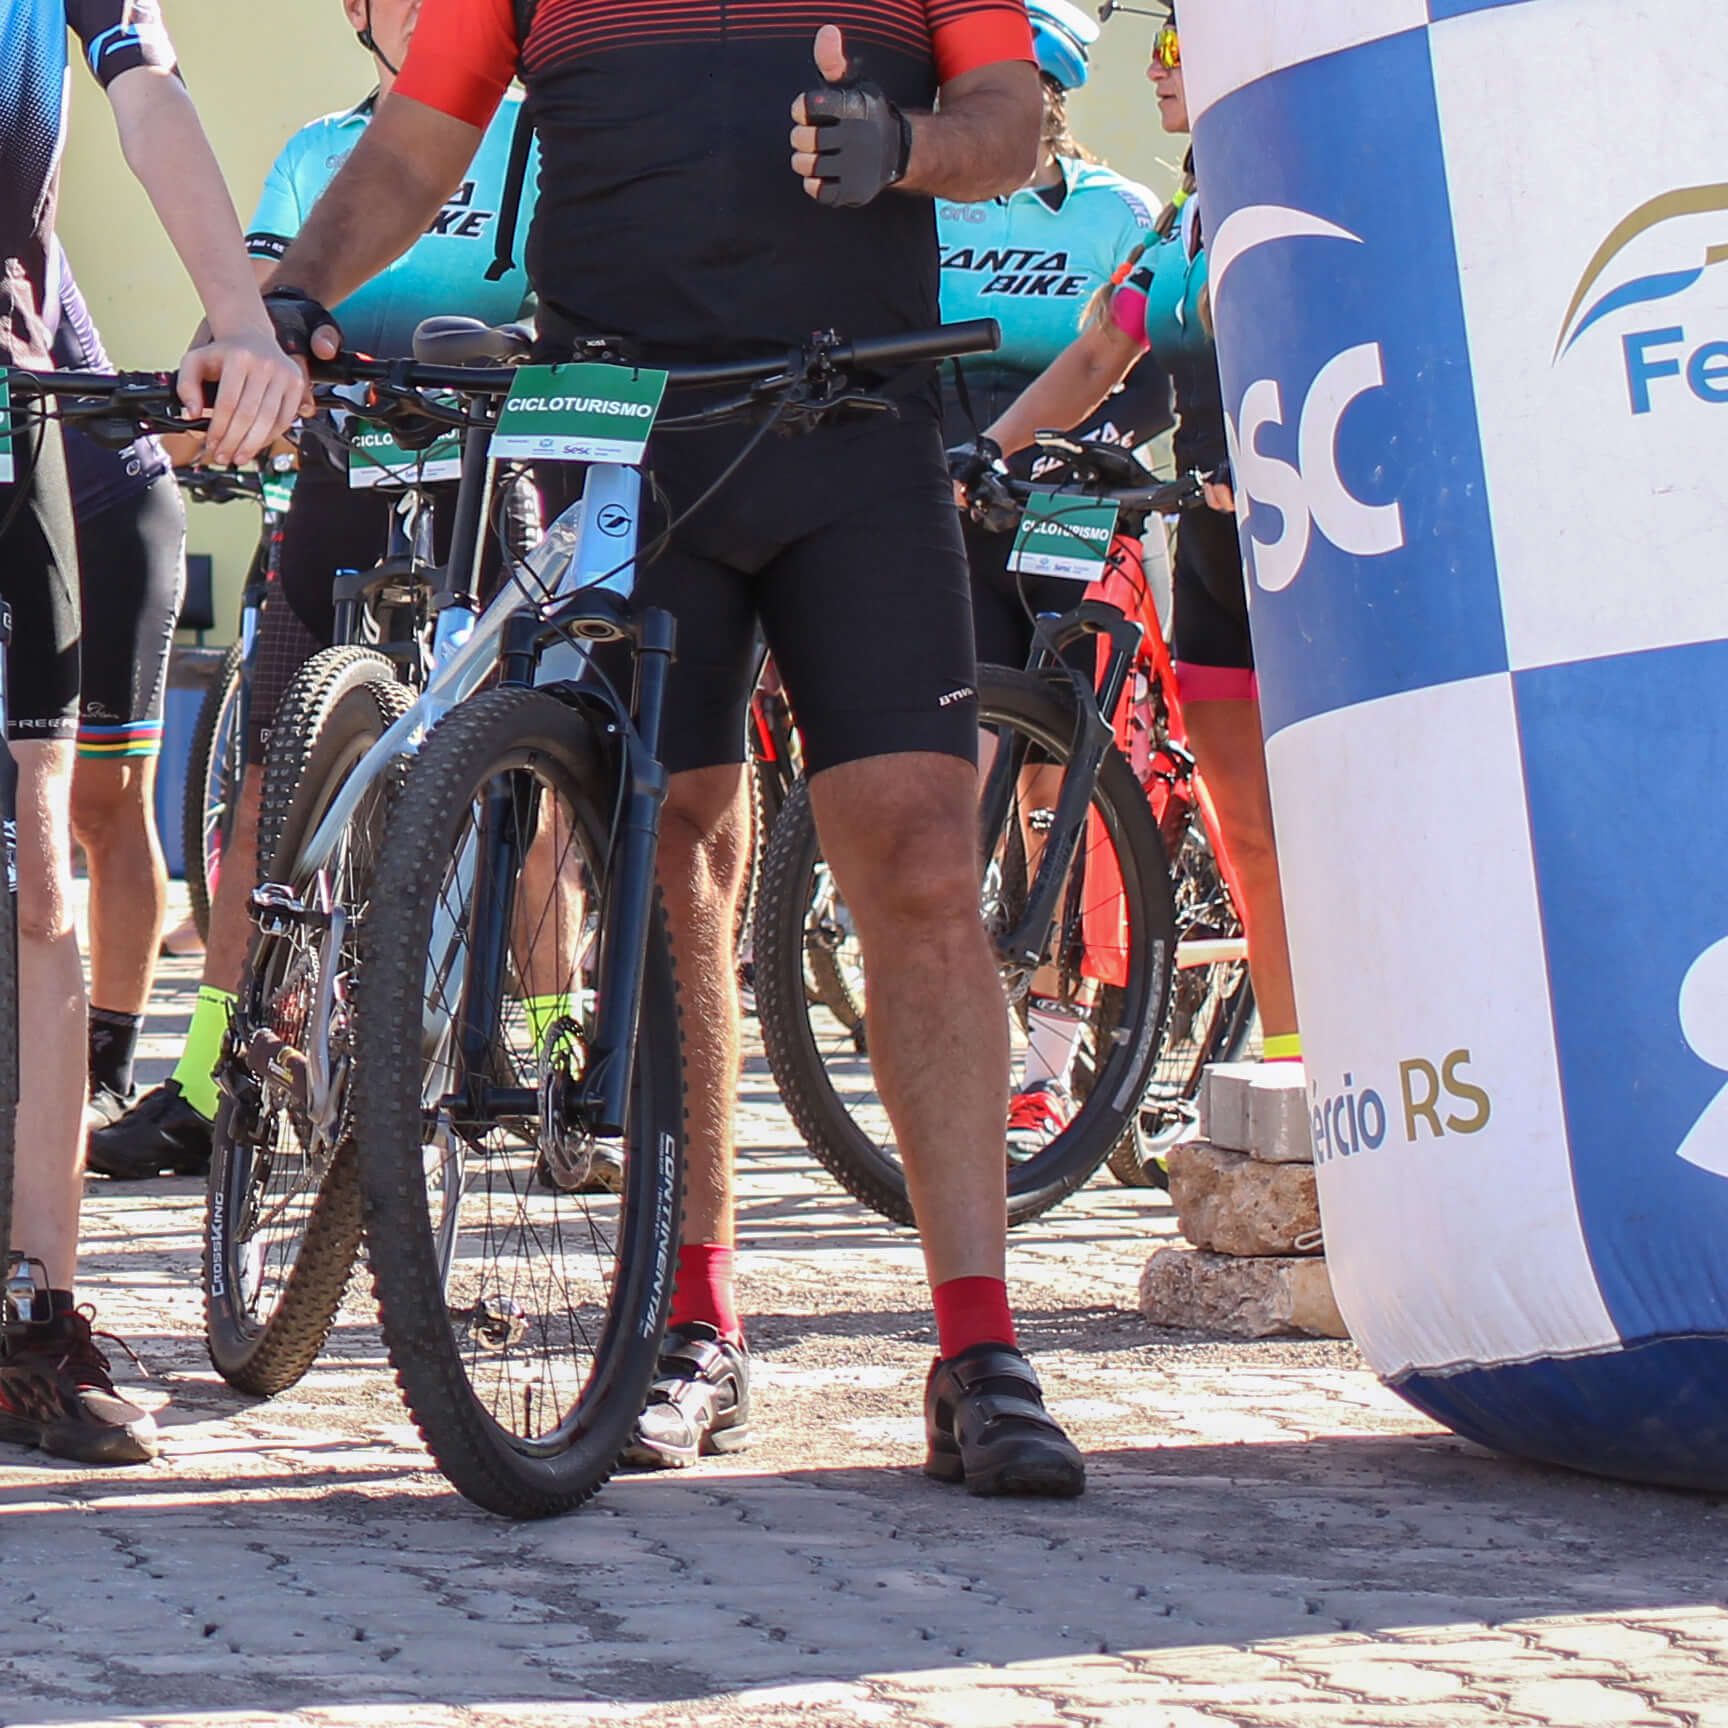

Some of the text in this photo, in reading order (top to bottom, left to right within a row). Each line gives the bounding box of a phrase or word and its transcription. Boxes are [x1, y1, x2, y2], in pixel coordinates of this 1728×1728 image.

[980, 275, 1090, 296] BIKE
[507, 396, 654, 419] CICLOTURISMO
[1398, 1048, 1491, 1144] RS
[643, 1132, 676, 1340] CONTINENTAL
